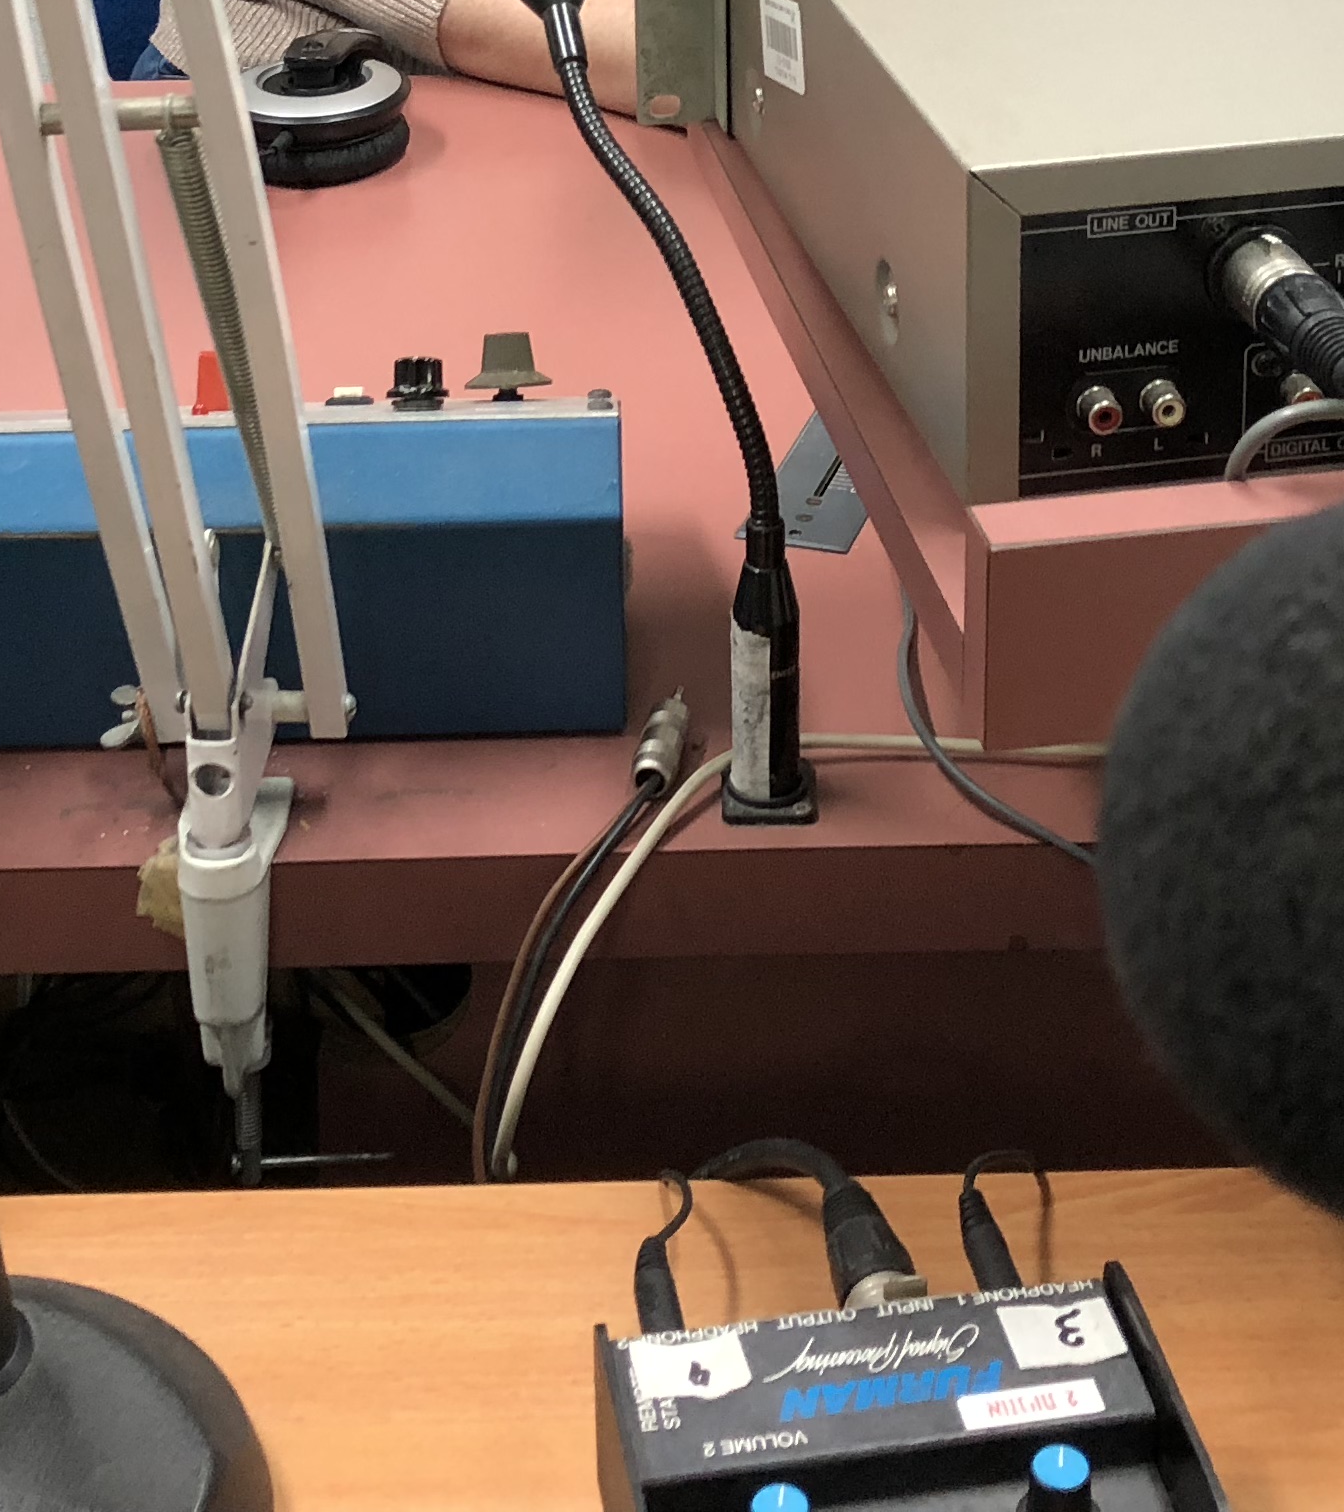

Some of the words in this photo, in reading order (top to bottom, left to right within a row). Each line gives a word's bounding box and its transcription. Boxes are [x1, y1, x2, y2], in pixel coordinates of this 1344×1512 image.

[1092, 215, 1130, 232] LINE
[1136, 212, 1171, 229] OUT
[1079, 339, 1179, 364] UNBALANCE
[1092, 444, 1103, 458] R
[1154, 438, 1164, 450] L
[1269, 438, 1331, 458] DIGITAL
[877, 1298, 935, 1318] INPUT
[776, 1309, 856, 1331] OUTPUT
[1055, 1309, 1085, 1348] 3
[780, 1357, 1003, 1423] FURMAN
[1067, 1390, 1079, 1407] 2
[703, 1441, 716, 1457] 2
[720, 1430, 808, 1456] VOLUME
